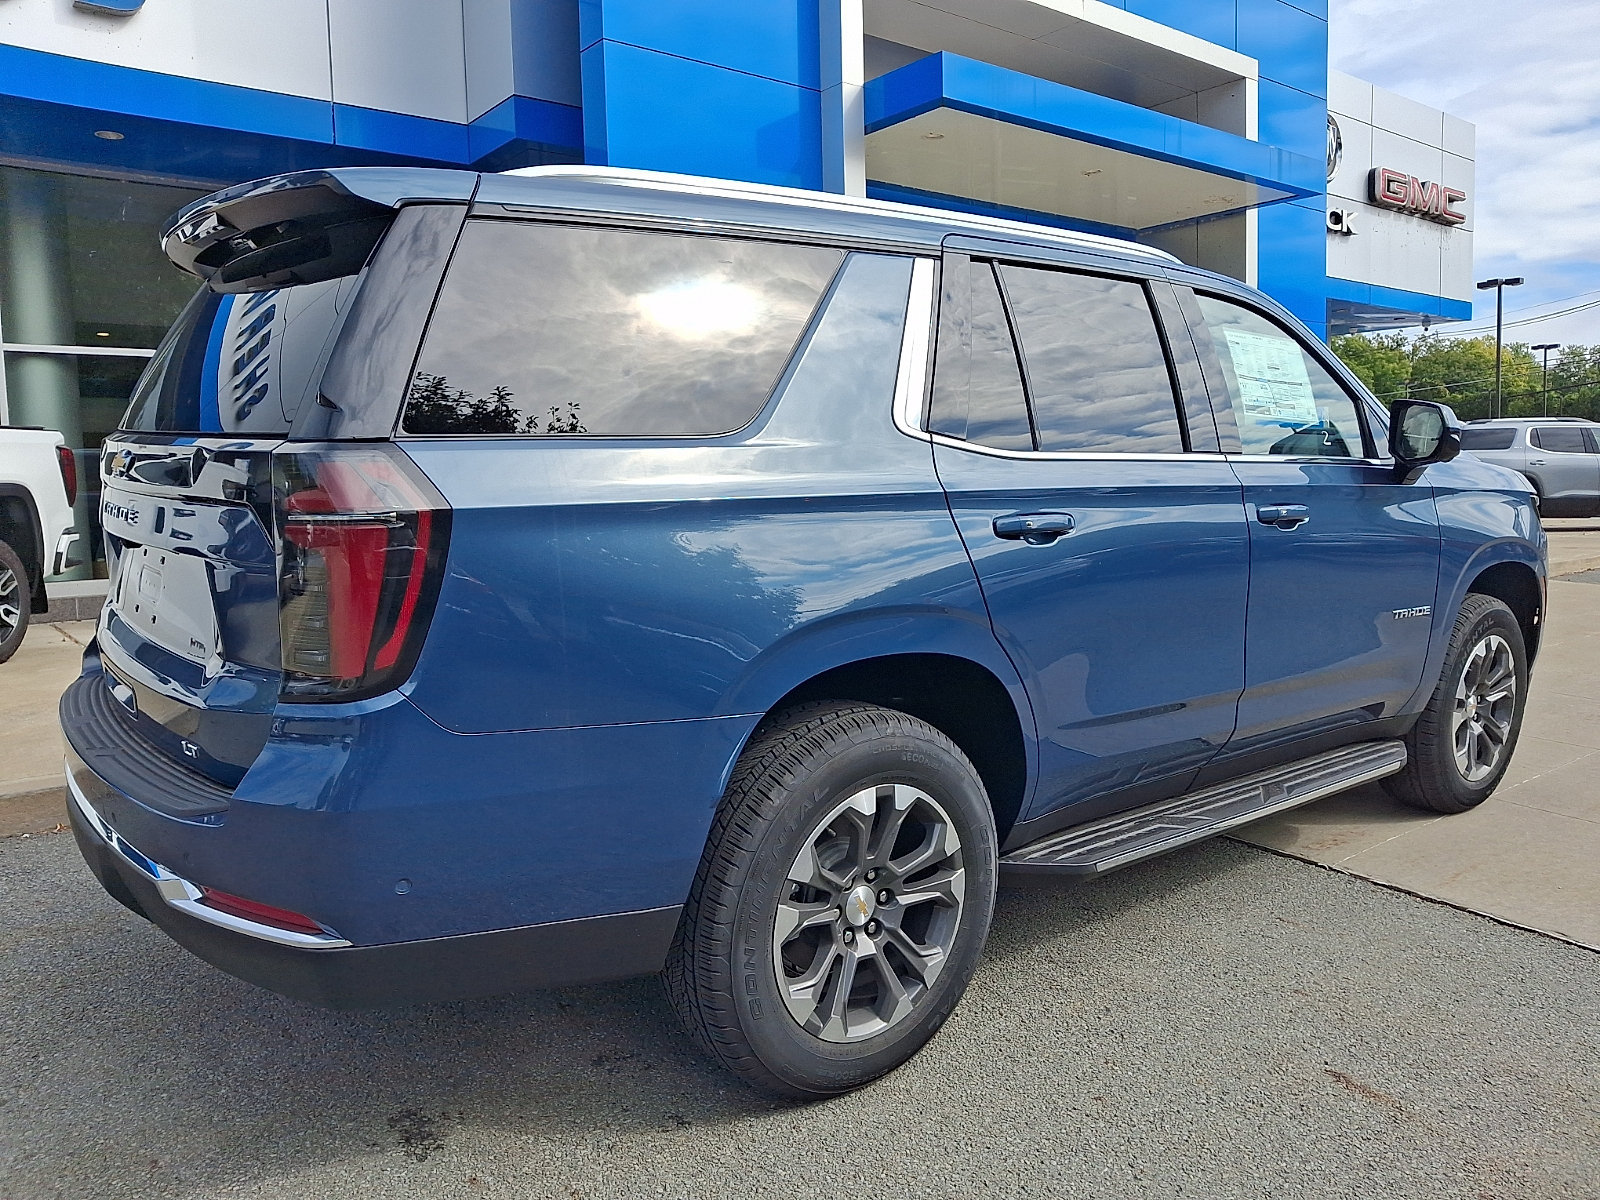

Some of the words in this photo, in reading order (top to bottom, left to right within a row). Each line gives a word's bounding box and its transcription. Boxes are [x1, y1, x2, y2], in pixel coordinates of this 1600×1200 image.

[1376, 166, 1467, 226] GMC
[1392, 605, 1431, 620] TAHOE
[180, 740, 199, 759] LT
[743, 786, 831, 1021] CONTINENTAL
